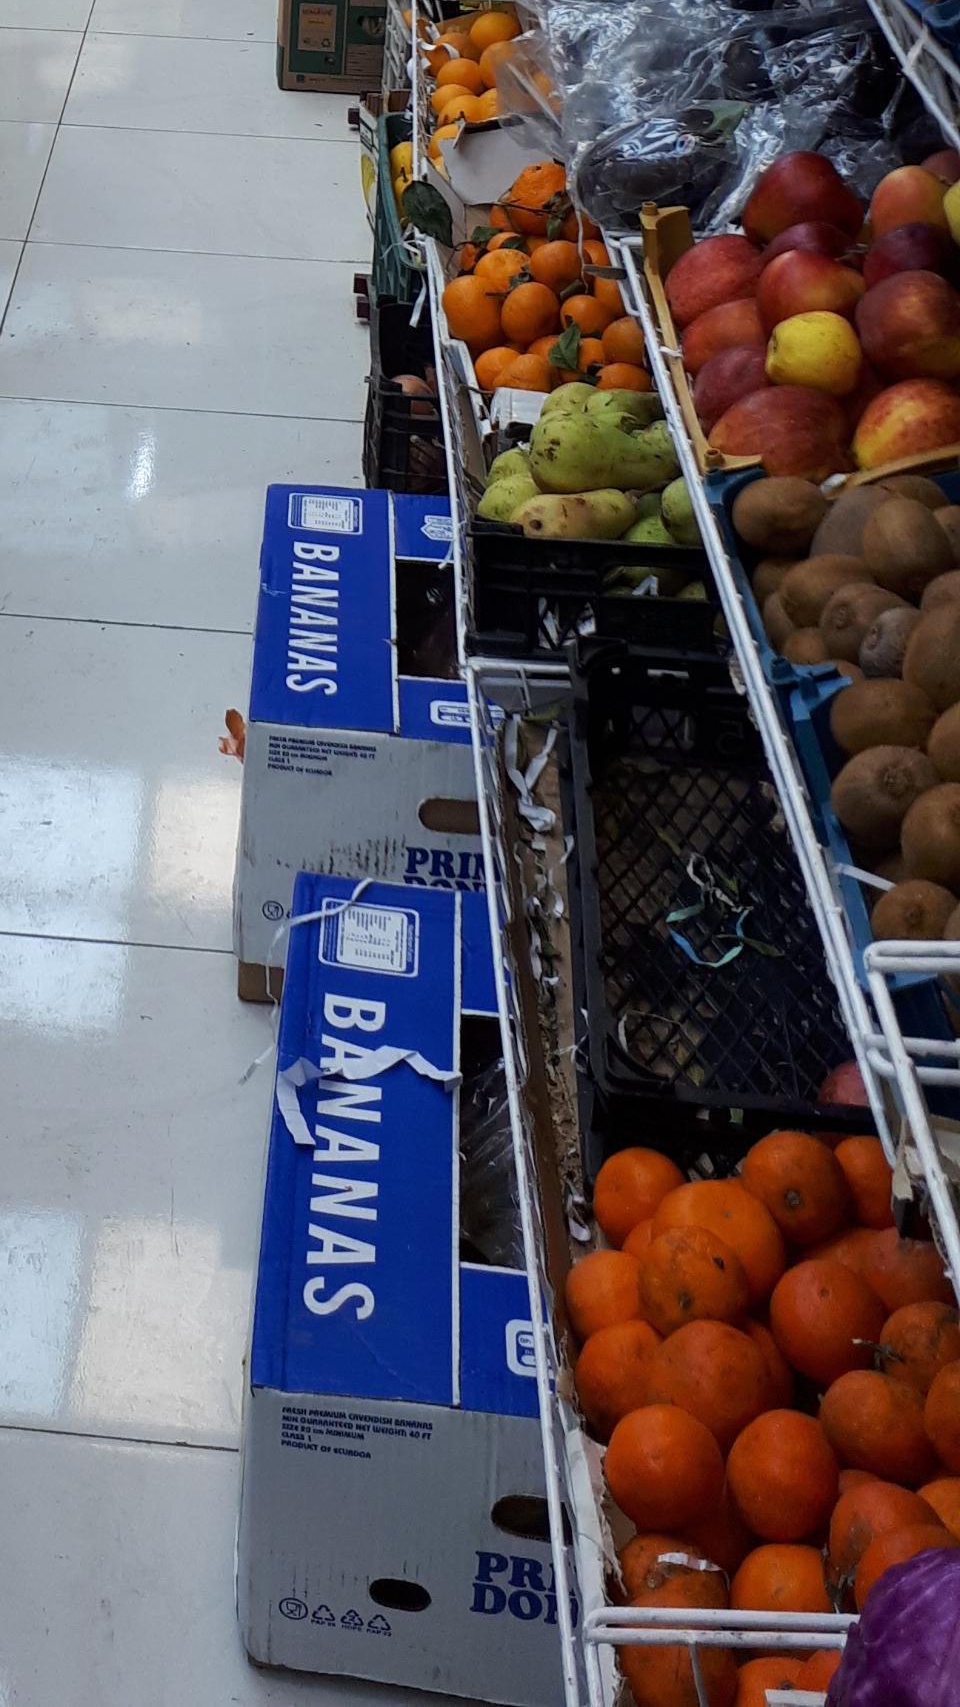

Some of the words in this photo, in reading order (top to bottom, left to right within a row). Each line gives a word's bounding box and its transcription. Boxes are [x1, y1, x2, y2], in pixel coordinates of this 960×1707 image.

[286, 541, 340, 695] BANANAS
[302, 992, 386, 1322] BANANAS
[282, 1406, 307, 1416] FRESH
[308, 1409, 347, 1419] PREMIUM
[348, 1412, 393, 1426] CAVENDISH
[395, 1419, 433, 1431] BANANAS
[355, 1423, 371, 1432] NET
[281, 1423, 299, 1431] SIZE
[325, 1428, 365, 1441] MINIMUM
[281, 1432, 305, 1441] CLASS
[281, 1440, 319, 1451] PRODUCT
[320, 1444, 331, 1453] OF
[333, 1447, 371, 1459] ECUADOR
